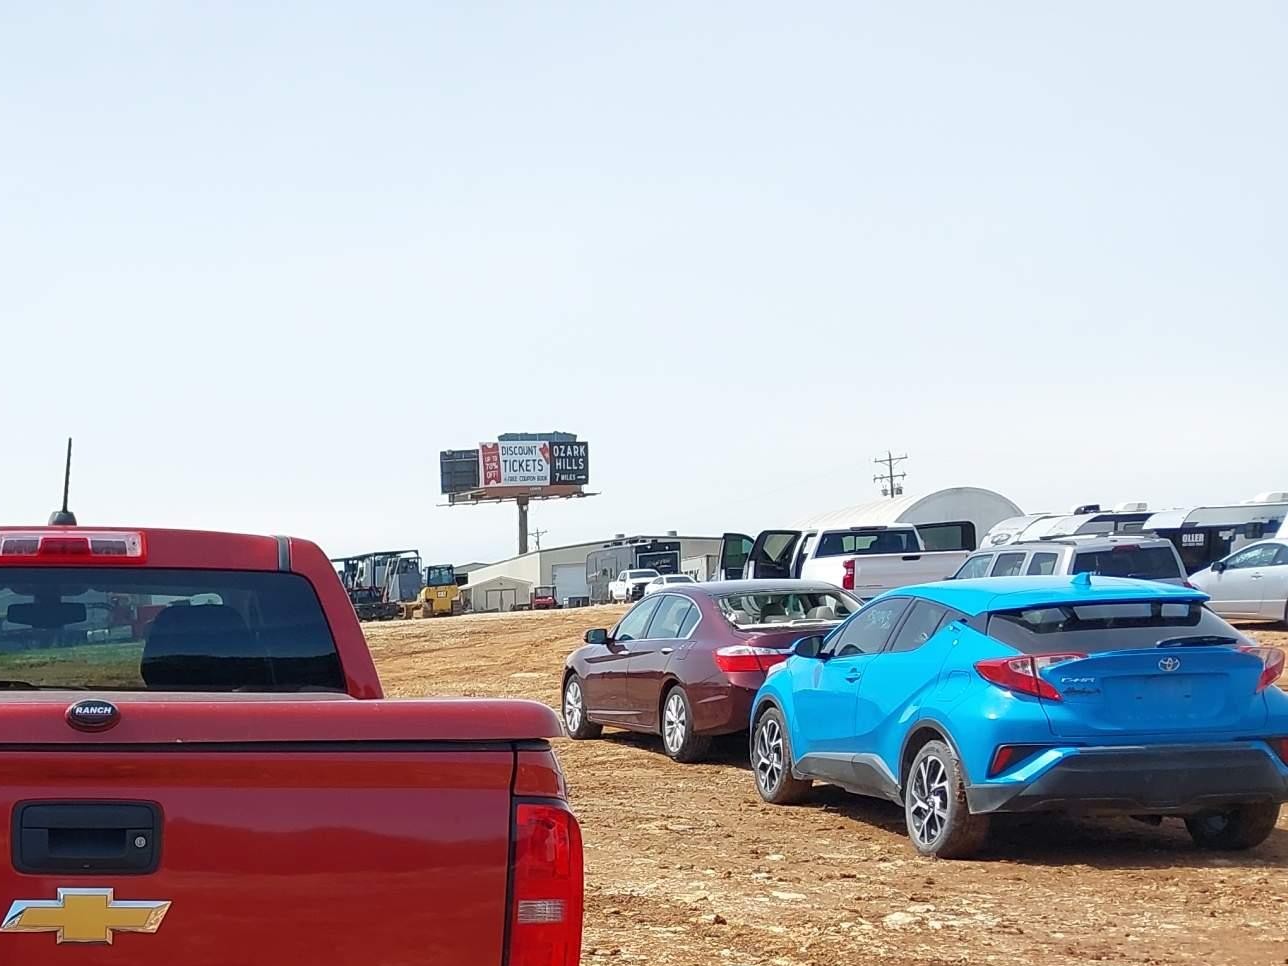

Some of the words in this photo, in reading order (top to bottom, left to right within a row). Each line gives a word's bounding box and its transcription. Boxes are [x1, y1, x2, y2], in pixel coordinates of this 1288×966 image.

[501, 446, 537, 456] DISCOUNT
[553, 445, 586, 457] OZARK
[503, 459, 544, 473] TICKETS
[555, 458, 584, 470] HILLS
[555, 473, 560, 482] 7
[561, 473, 576, 481] MILES
[75, 706, 112, 714] RANCH
